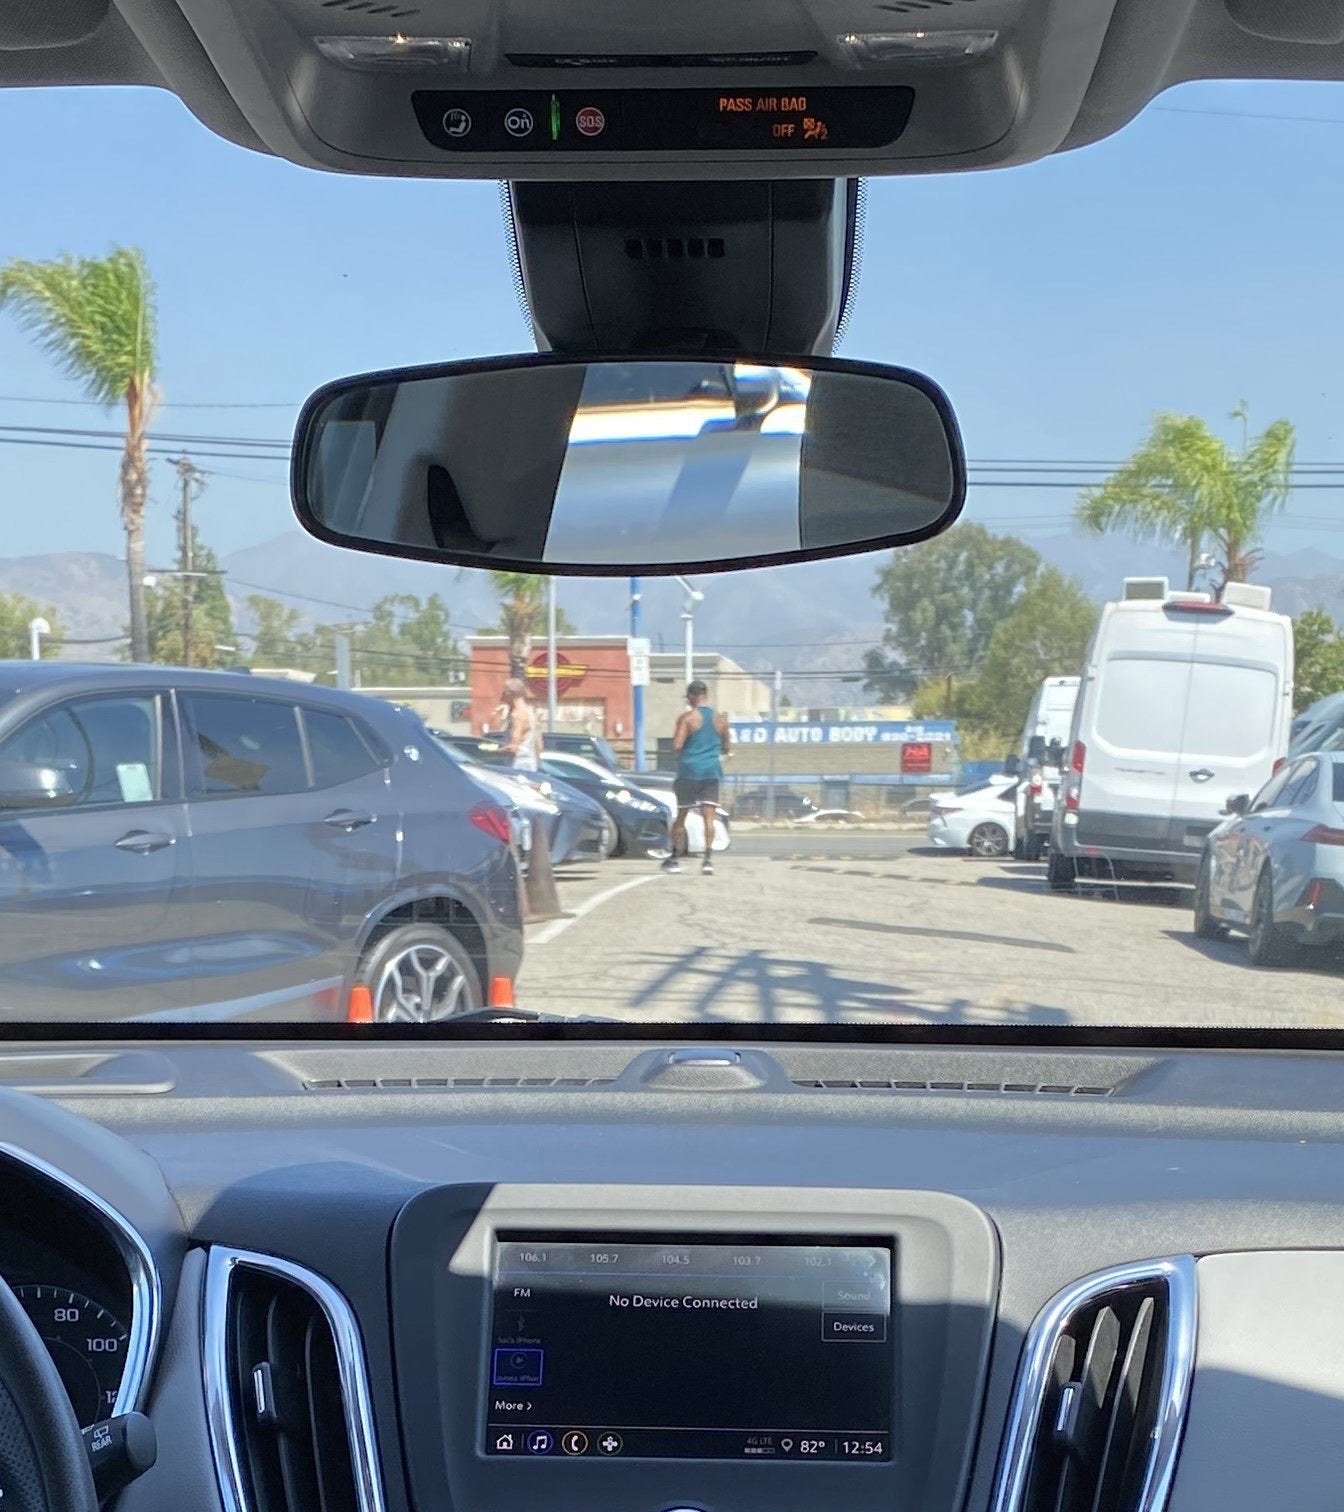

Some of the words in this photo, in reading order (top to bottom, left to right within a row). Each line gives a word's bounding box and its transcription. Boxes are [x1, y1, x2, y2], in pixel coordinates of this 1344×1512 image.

[719, 97, 752, 112] PASS
[756, 97, 778, 112] AIR
[579, 115, 605, 129] SOS
[772, 123, 795, 138] OFF
[774, 726, 824, 743] AUTO
[828, 726, 877, 742] BODY
[590, 1253, 619, 1263] 105.7
[661, 1254, 690, 1265] 104.5
[513, 1288, 531, 1298] FM
[608, 1294, 629, 1308] No
[632, 1295, 679, 1308] Device
[682, 1296, 758, 1309] Connected
[54, 1308, 80, 1322] 80
[833, 1321, 875, 1333] Devices
[86, 1338, 118, 1352] 100
[494, 1400, 524, 1411] More
[90, 1435, 114, 1452] REAR
[759, 1436, 773, 1446] LTE
[842, 1440, 883, 1455] 12:54
